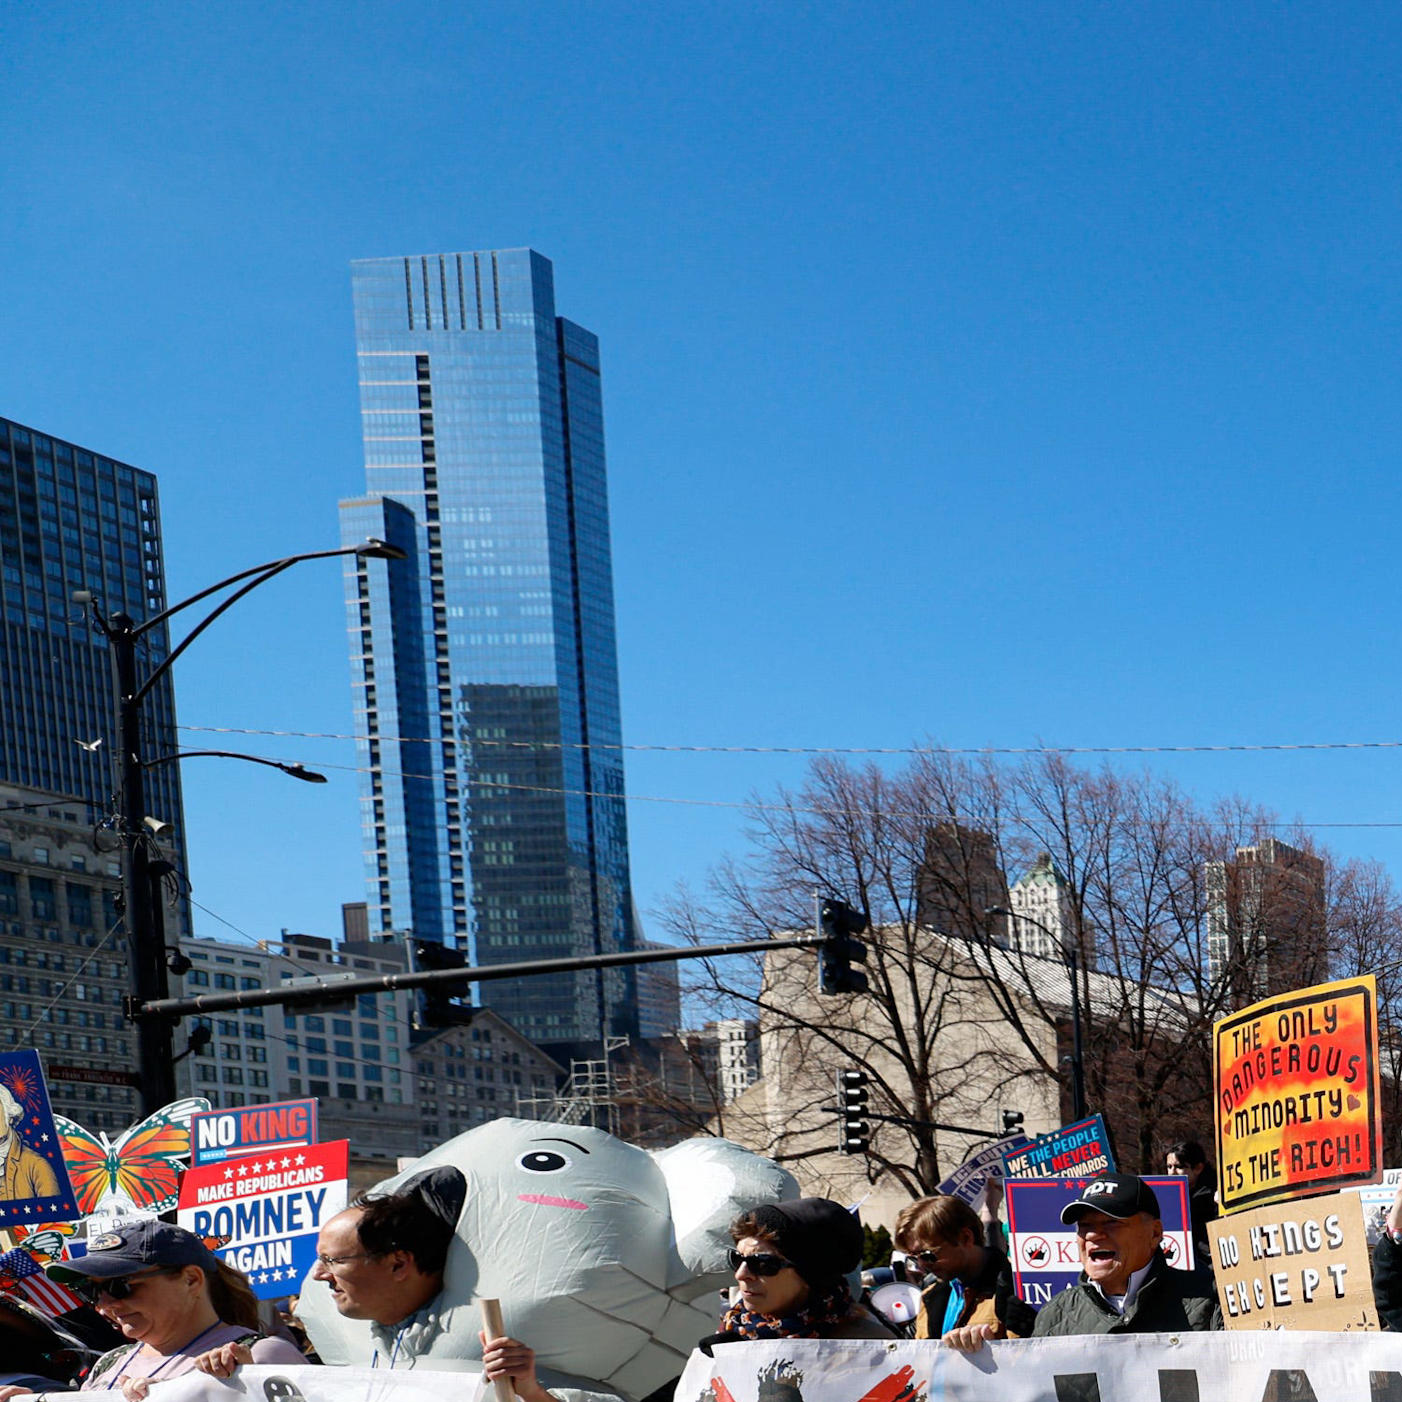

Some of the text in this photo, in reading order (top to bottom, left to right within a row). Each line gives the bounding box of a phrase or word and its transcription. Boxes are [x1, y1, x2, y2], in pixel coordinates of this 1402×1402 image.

[1232, 1004, 1337, 1058] THE ONLY
[1222, 1043, 1361, 1117] DANGEROUS
[198, 1107, 308, 1149] NO KING
[1234, 1088, 1342, 1140] MINORITY
[1007, 1154, 1030, 1174] WE
[1029, 1146, 1052, 1166] THE
[1053, 1126, 1099, 1156] PEOPLE
[1052, 1140, 1102, 1171] NEVER
[1060, 1155, 1108, 1178] COWARDS
[1226, 1134, 1361, 1193] IS THE RICH!
[197, 1165, 324, 1204] MAKE REPUBLICANS
[1083, 1182, 1118, 1199] FDT
[194, 1188, 327, 1242] ROMNEY
[225, 1240, 292, 1273] AGAIN
[1217, 1214, 1344, 1270] NO KINGS
[1022, 1283, 1051, 1305] IN
[1224, 1263, 1348, 1317] EXCEPT
